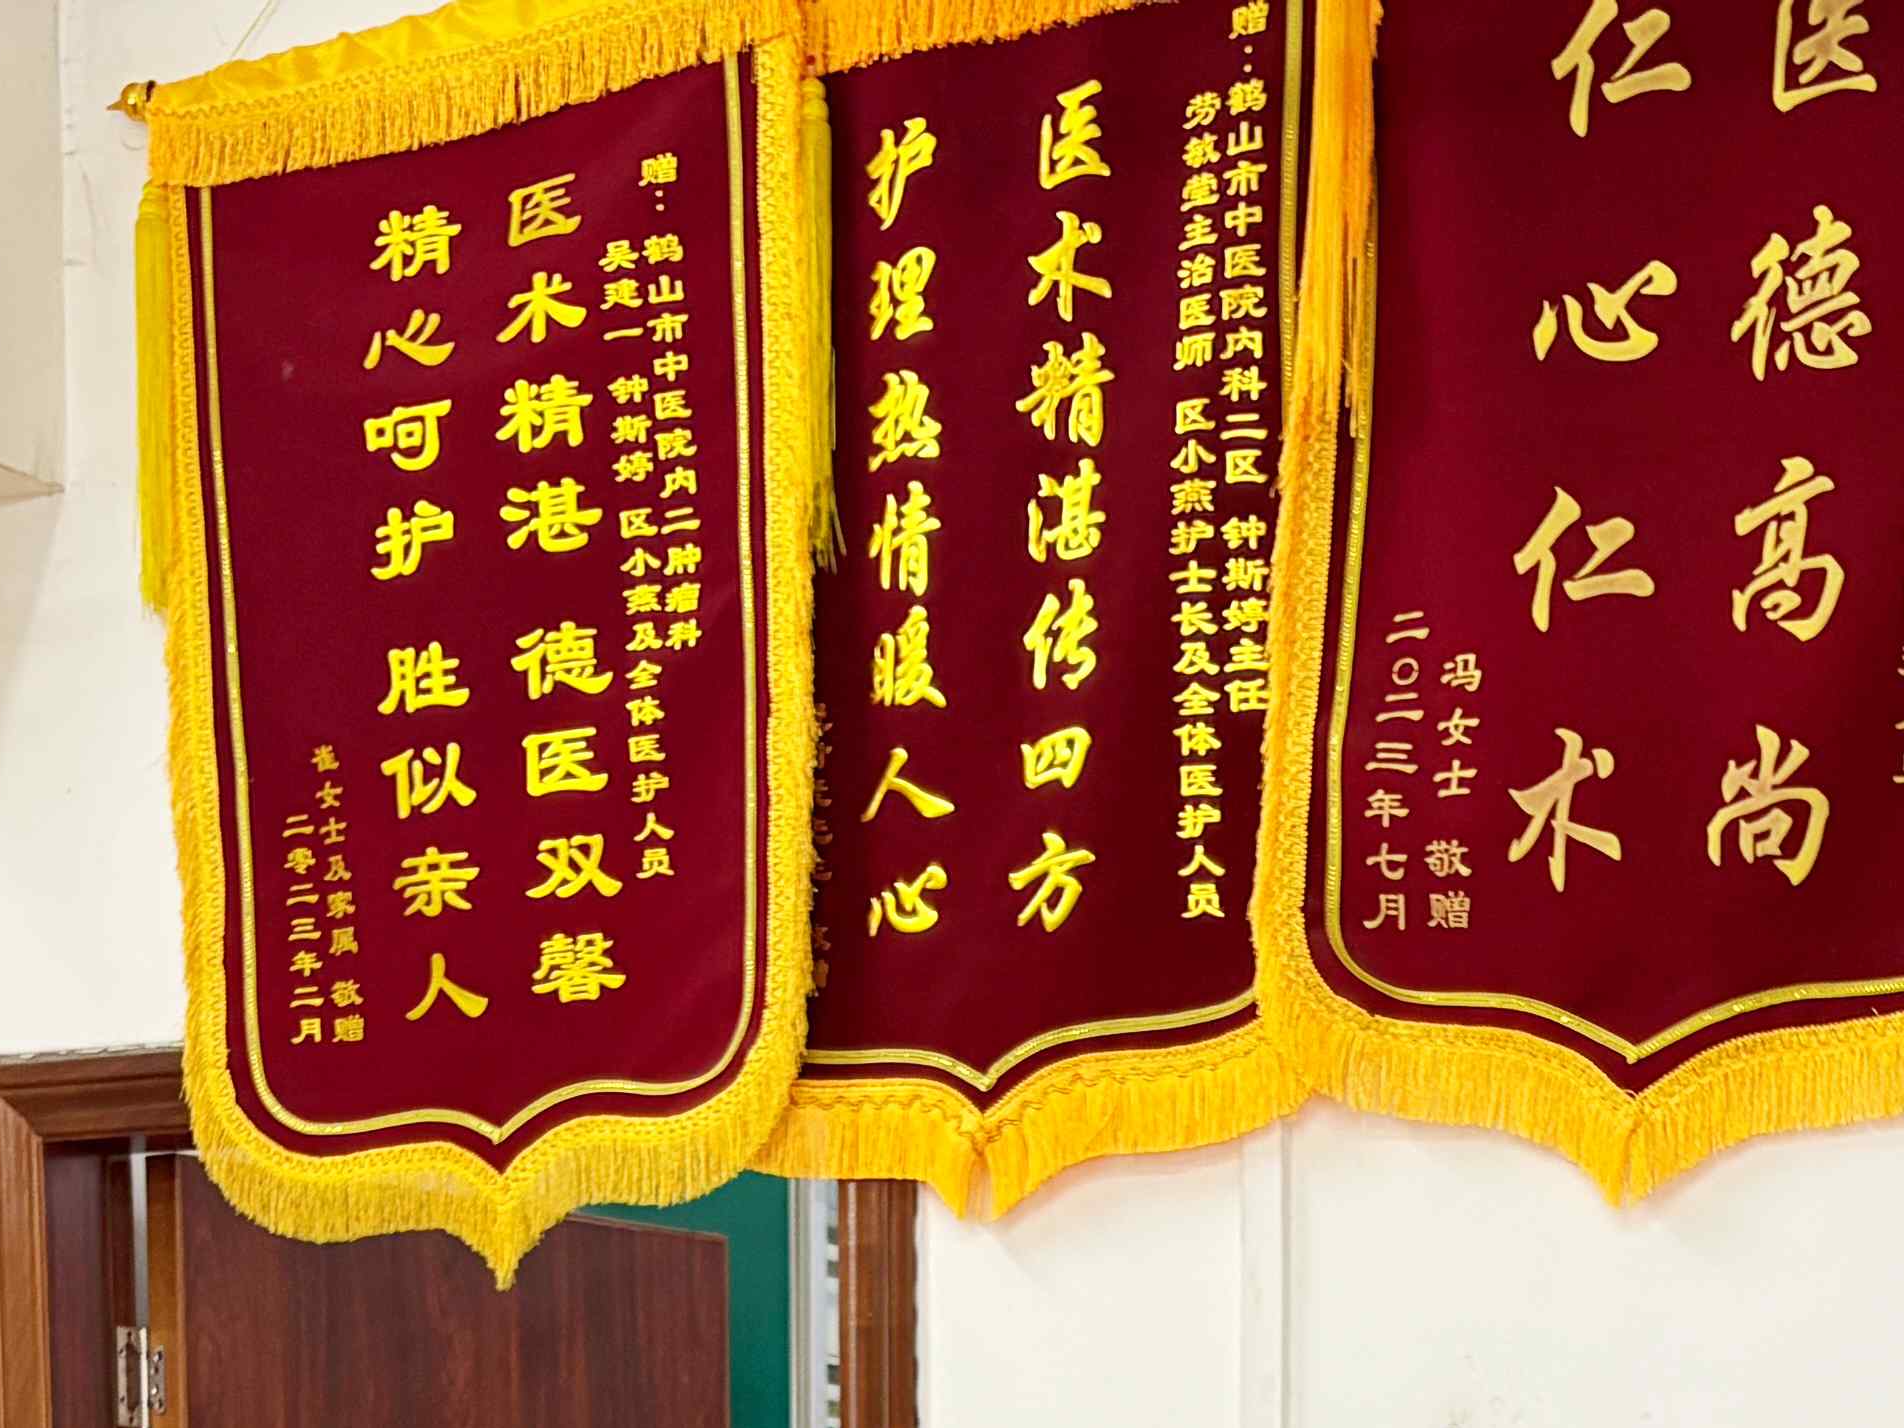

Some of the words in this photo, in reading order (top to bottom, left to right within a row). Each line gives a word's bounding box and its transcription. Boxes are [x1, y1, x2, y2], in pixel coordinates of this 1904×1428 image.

[363, 205, 462, 581] 精心呵护
[496, 172, 603, 552] 医术精湛
[861, 116, 955, 936] 护理热情暖人心
[1008, 79, 1115, 932] 医术精湛传四方
[1507, 0, 1693, 892] 仁心仁术
[377, 641, 489, 1020] 胜似亲人
[511, 621, 627, 1004] 德医双馨
[1425, 839, 1472, 930] 敬赠
[1433, 651, 1483, 799] 冯女士
[282, 814, 326, 1044] 二零二三年二月
